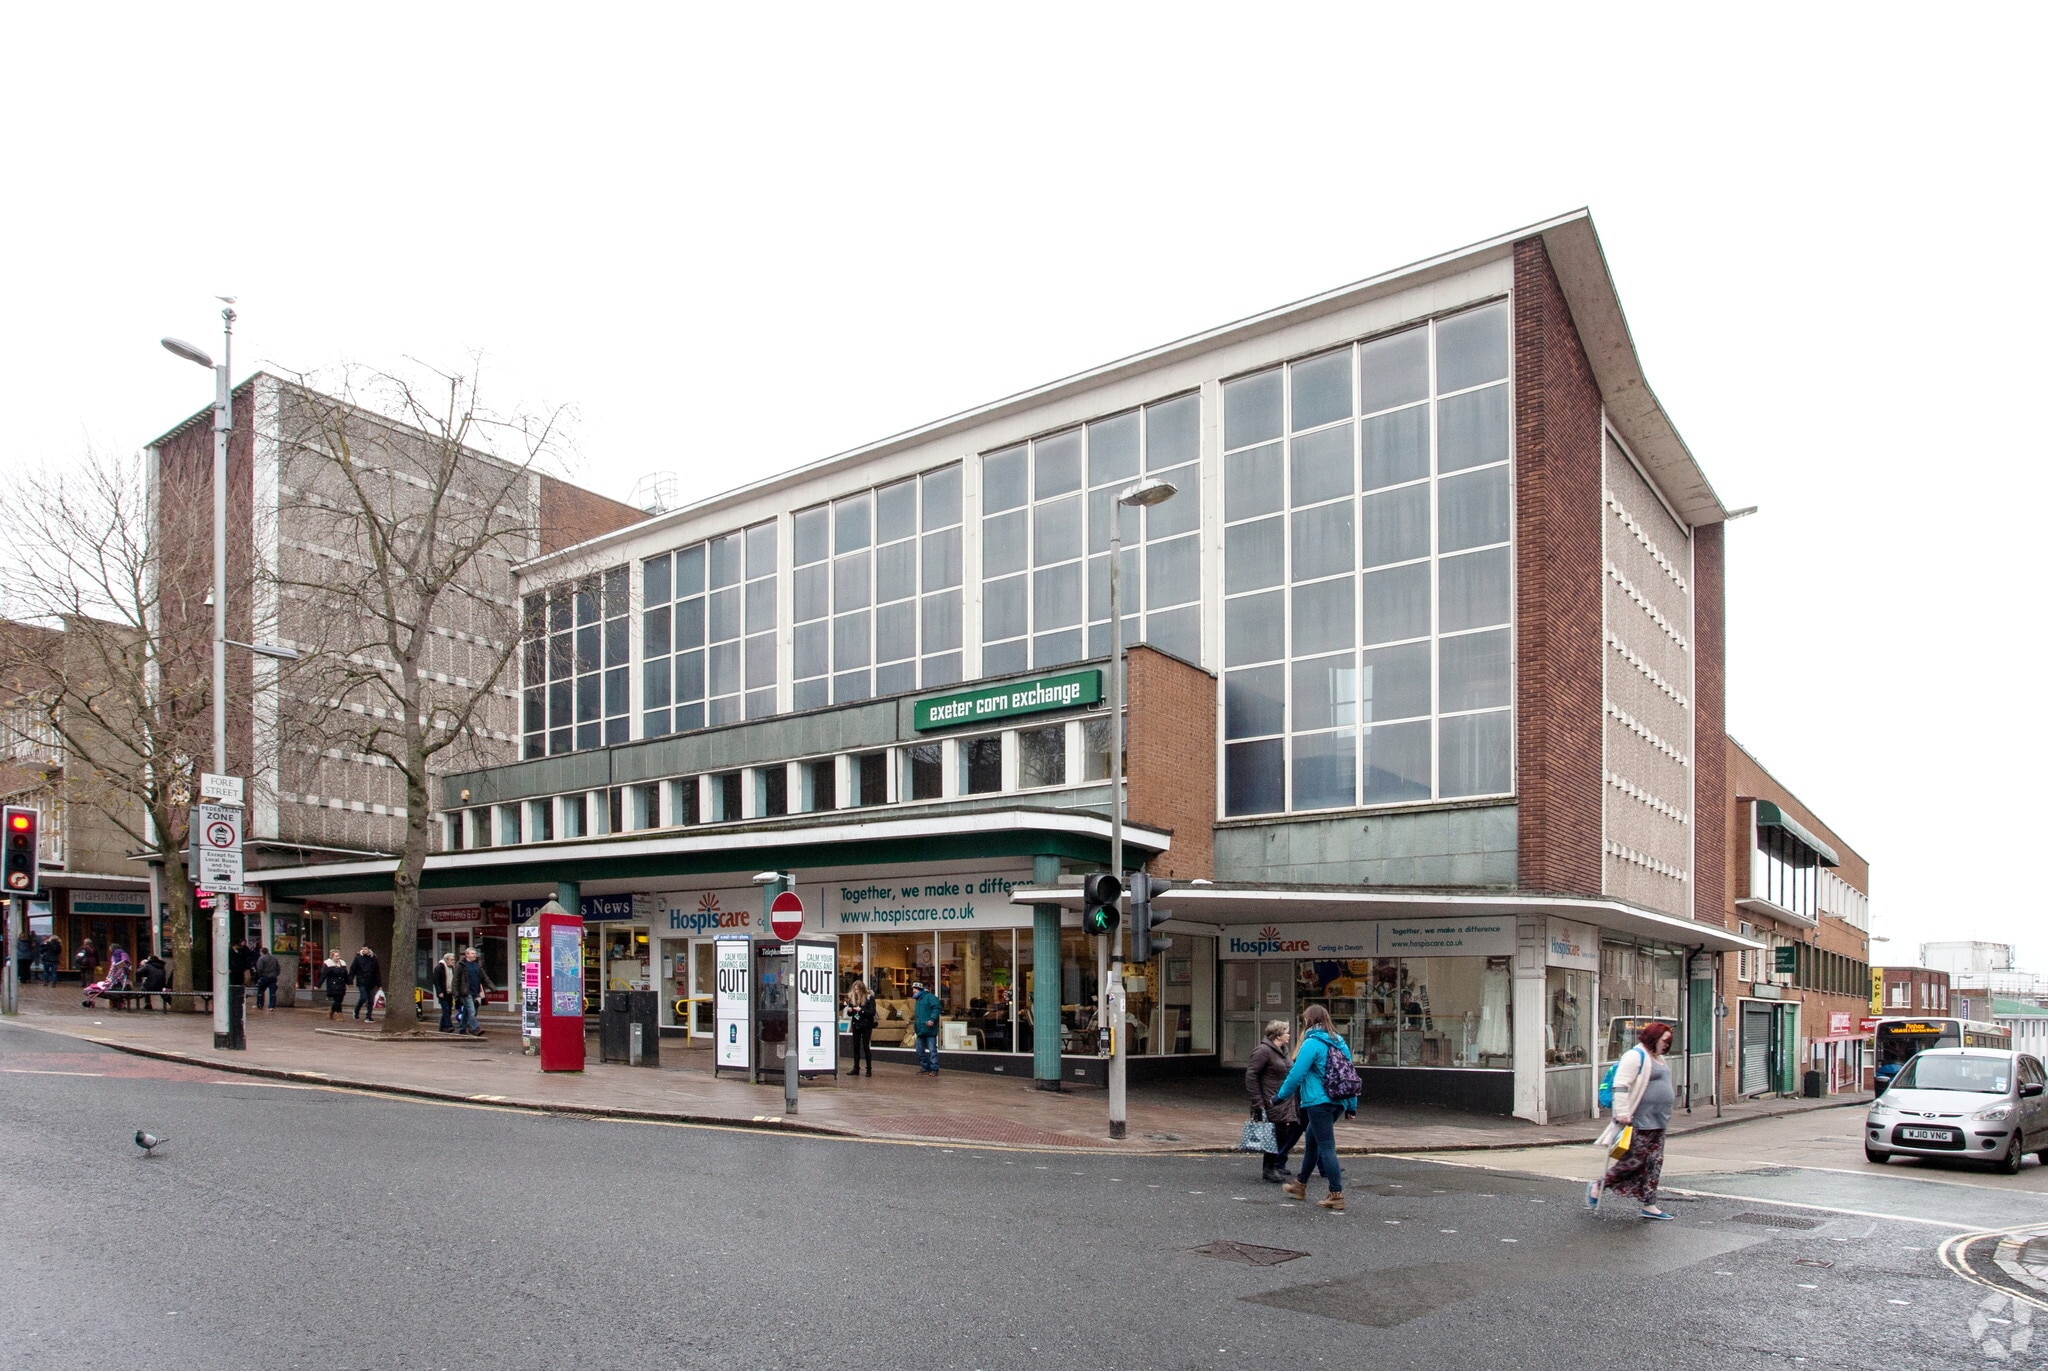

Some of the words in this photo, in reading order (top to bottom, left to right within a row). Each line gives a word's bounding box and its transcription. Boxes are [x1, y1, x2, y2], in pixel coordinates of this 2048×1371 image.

[930, 701, 972, 721] exeter
[976, 695, 1008, 714] corn
[1012, 682, 1080, 708] exchange
[210, 777, 234, 787] FORE
[205, 786, 239, 797] STREET
[206, 812, 234, 822] ZONE
[73, 892, 100, 901] HIGH
[105, 893, 146, 902] MIGHTY
[841, 885, 896, 904] Together,
[901, 887, 920, 898] we
[925, 881, 959, 897] make
[965, 884, 973, 894] a
[593, 899, 630, 915] News
[841, 902, 974, 926] www.hospiscare.co.uk
[670, 908, 750, 934] Hospiscare
[1230, 937, 1310, 956] Hospiscare
[1391, 939, 1463, 948] www.hospiscare.co.uk
[807, 953, 819, 961] CALM
[821, 954, 832, 962] YOUR
[800, 961, 823, 969] CRAVINGS
[823, 962, 832, 970] AND
[719, 969, 747, 993] QUIT
[800, 969, 832, 995] QUIT
[810, 994, 819, 1002] FOR
[820, 995, 832, 1003] GOOD
[1908, 1130, 1928, 1138] WJ10
[1930, 1131, 1948, 1140] VNG
